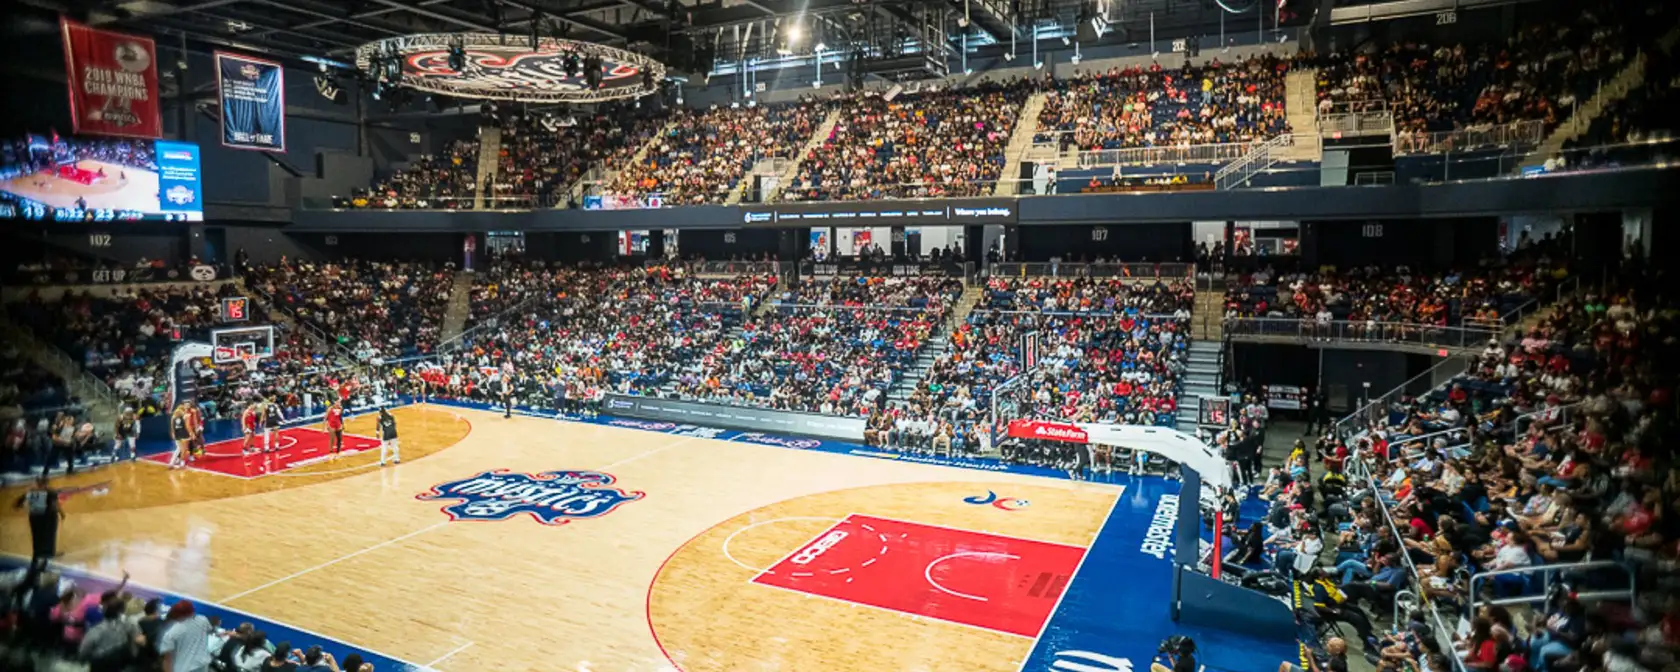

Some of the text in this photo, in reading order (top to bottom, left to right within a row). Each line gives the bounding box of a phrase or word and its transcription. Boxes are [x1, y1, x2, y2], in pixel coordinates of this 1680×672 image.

[114, 70, 146, 88] WNBA
[84, 81, 149, 101] CHAMPIONS
[1092, 229, 1108, 241] 107
[1362, 224, 1383, 237] 108
[89, 234, 111, 246] 102
[92, 269, 111, 281] GET
[1211, 408, 1224, 424] 15
[1047, 427, 1086, 440] State Farm
[790, 528, 849, 565] GEICO
